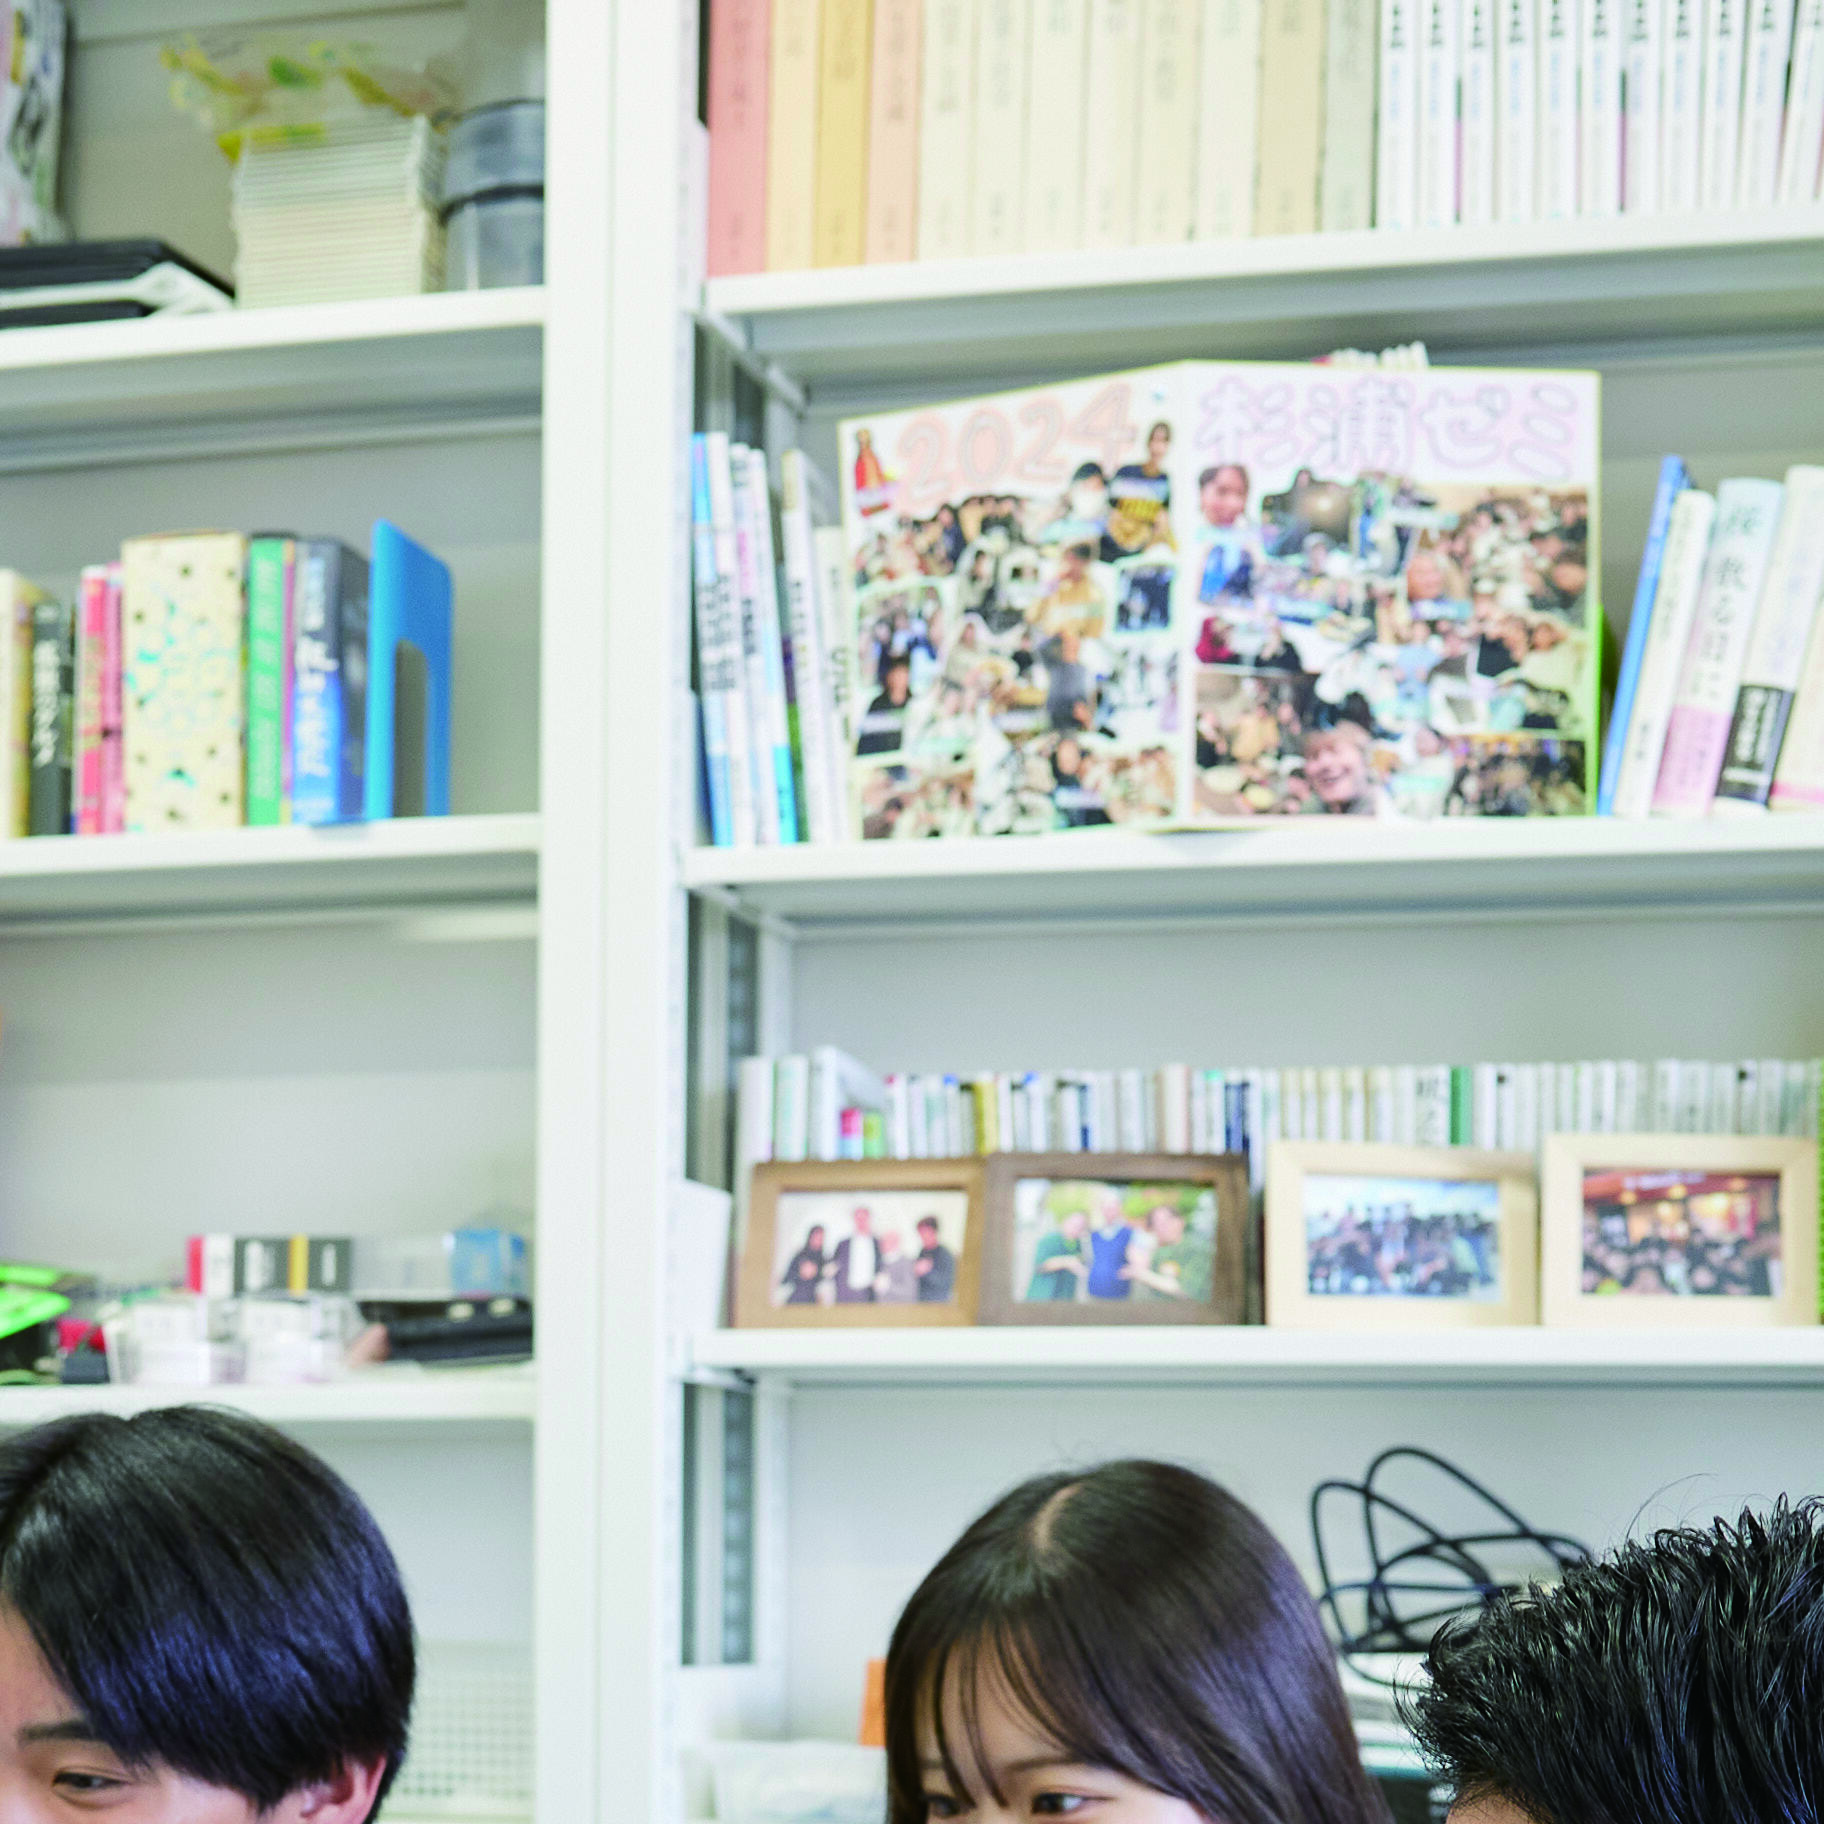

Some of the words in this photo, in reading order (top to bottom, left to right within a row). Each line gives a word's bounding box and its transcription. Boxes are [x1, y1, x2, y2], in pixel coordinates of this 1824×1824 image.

[898, 382, 1138, 500] 2024
[1196, 374, 1582, 480] 杉浦ゼミ
